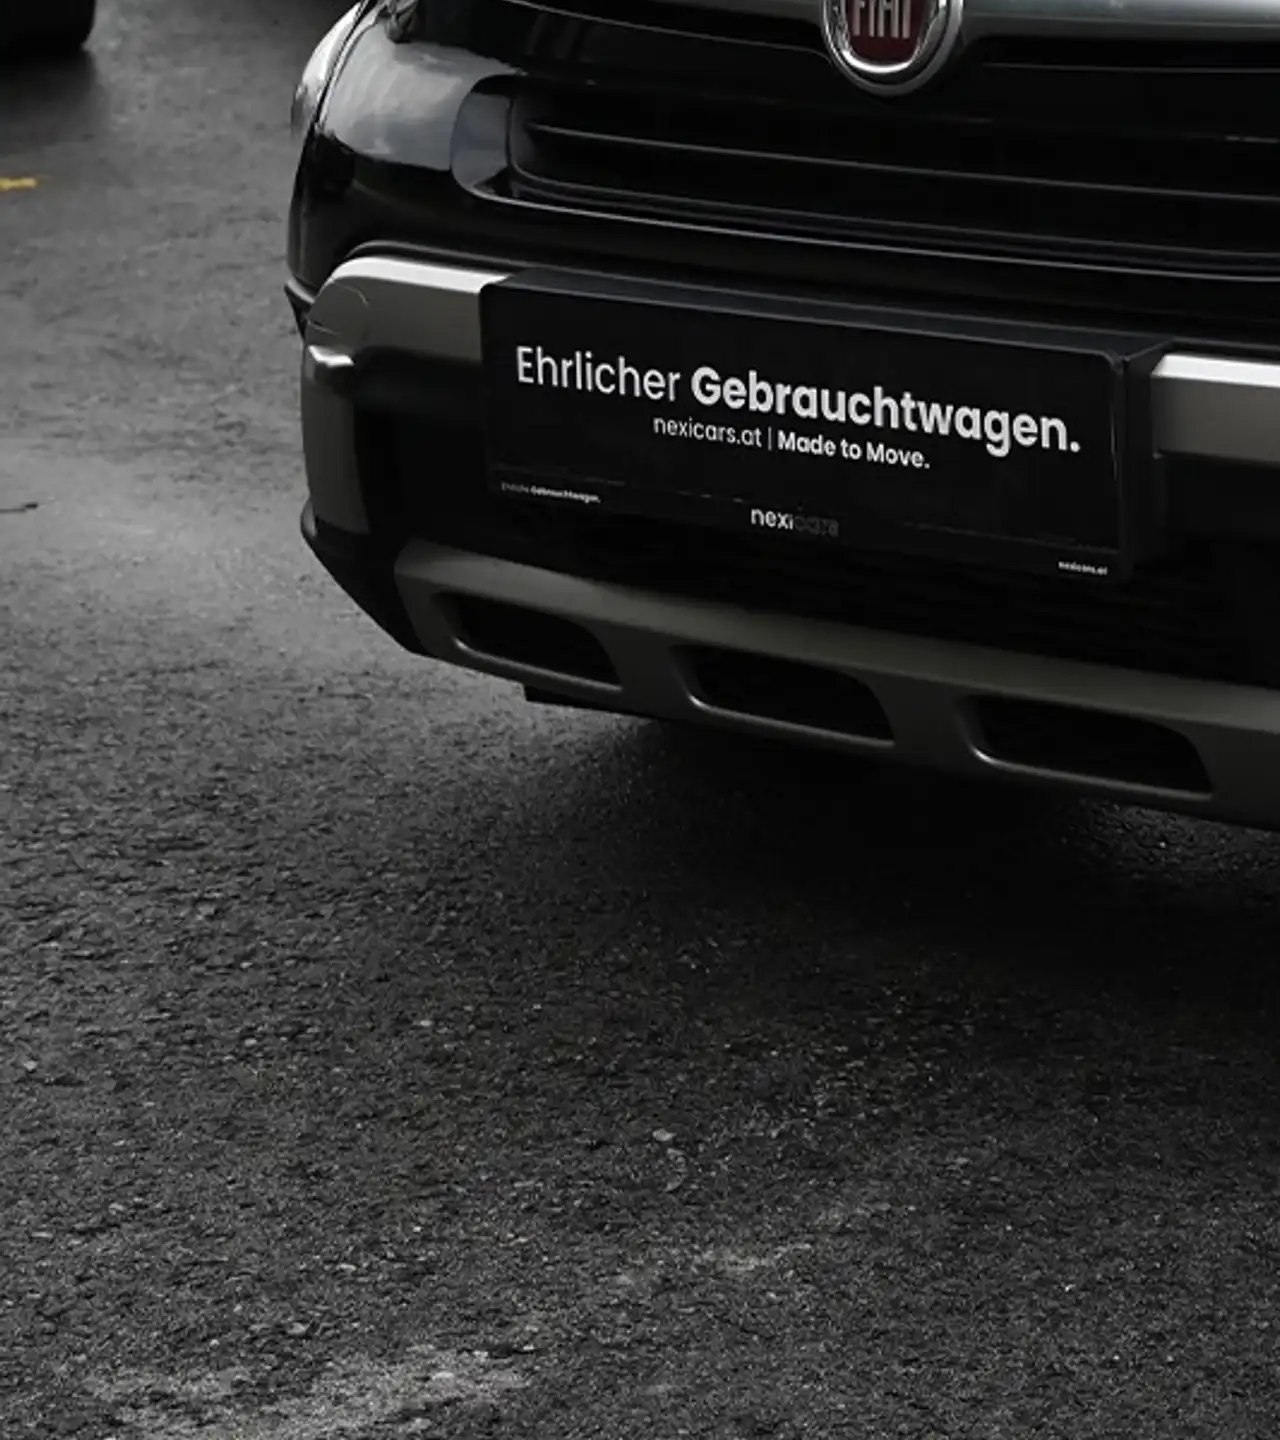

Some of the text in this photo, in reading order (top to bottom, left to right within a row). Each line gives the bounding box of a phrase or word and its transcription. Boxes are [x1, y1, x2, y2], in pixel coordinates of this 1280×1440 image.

[516, 345, 1081, 458] Ehrlicher Gebrauchtwagen.
[652, 415, 763, 449] nexicars.at
[777, 428, 837, 457] Made
[840, 438, 862, 460] to
[866, 441, 931, 469] Move.
